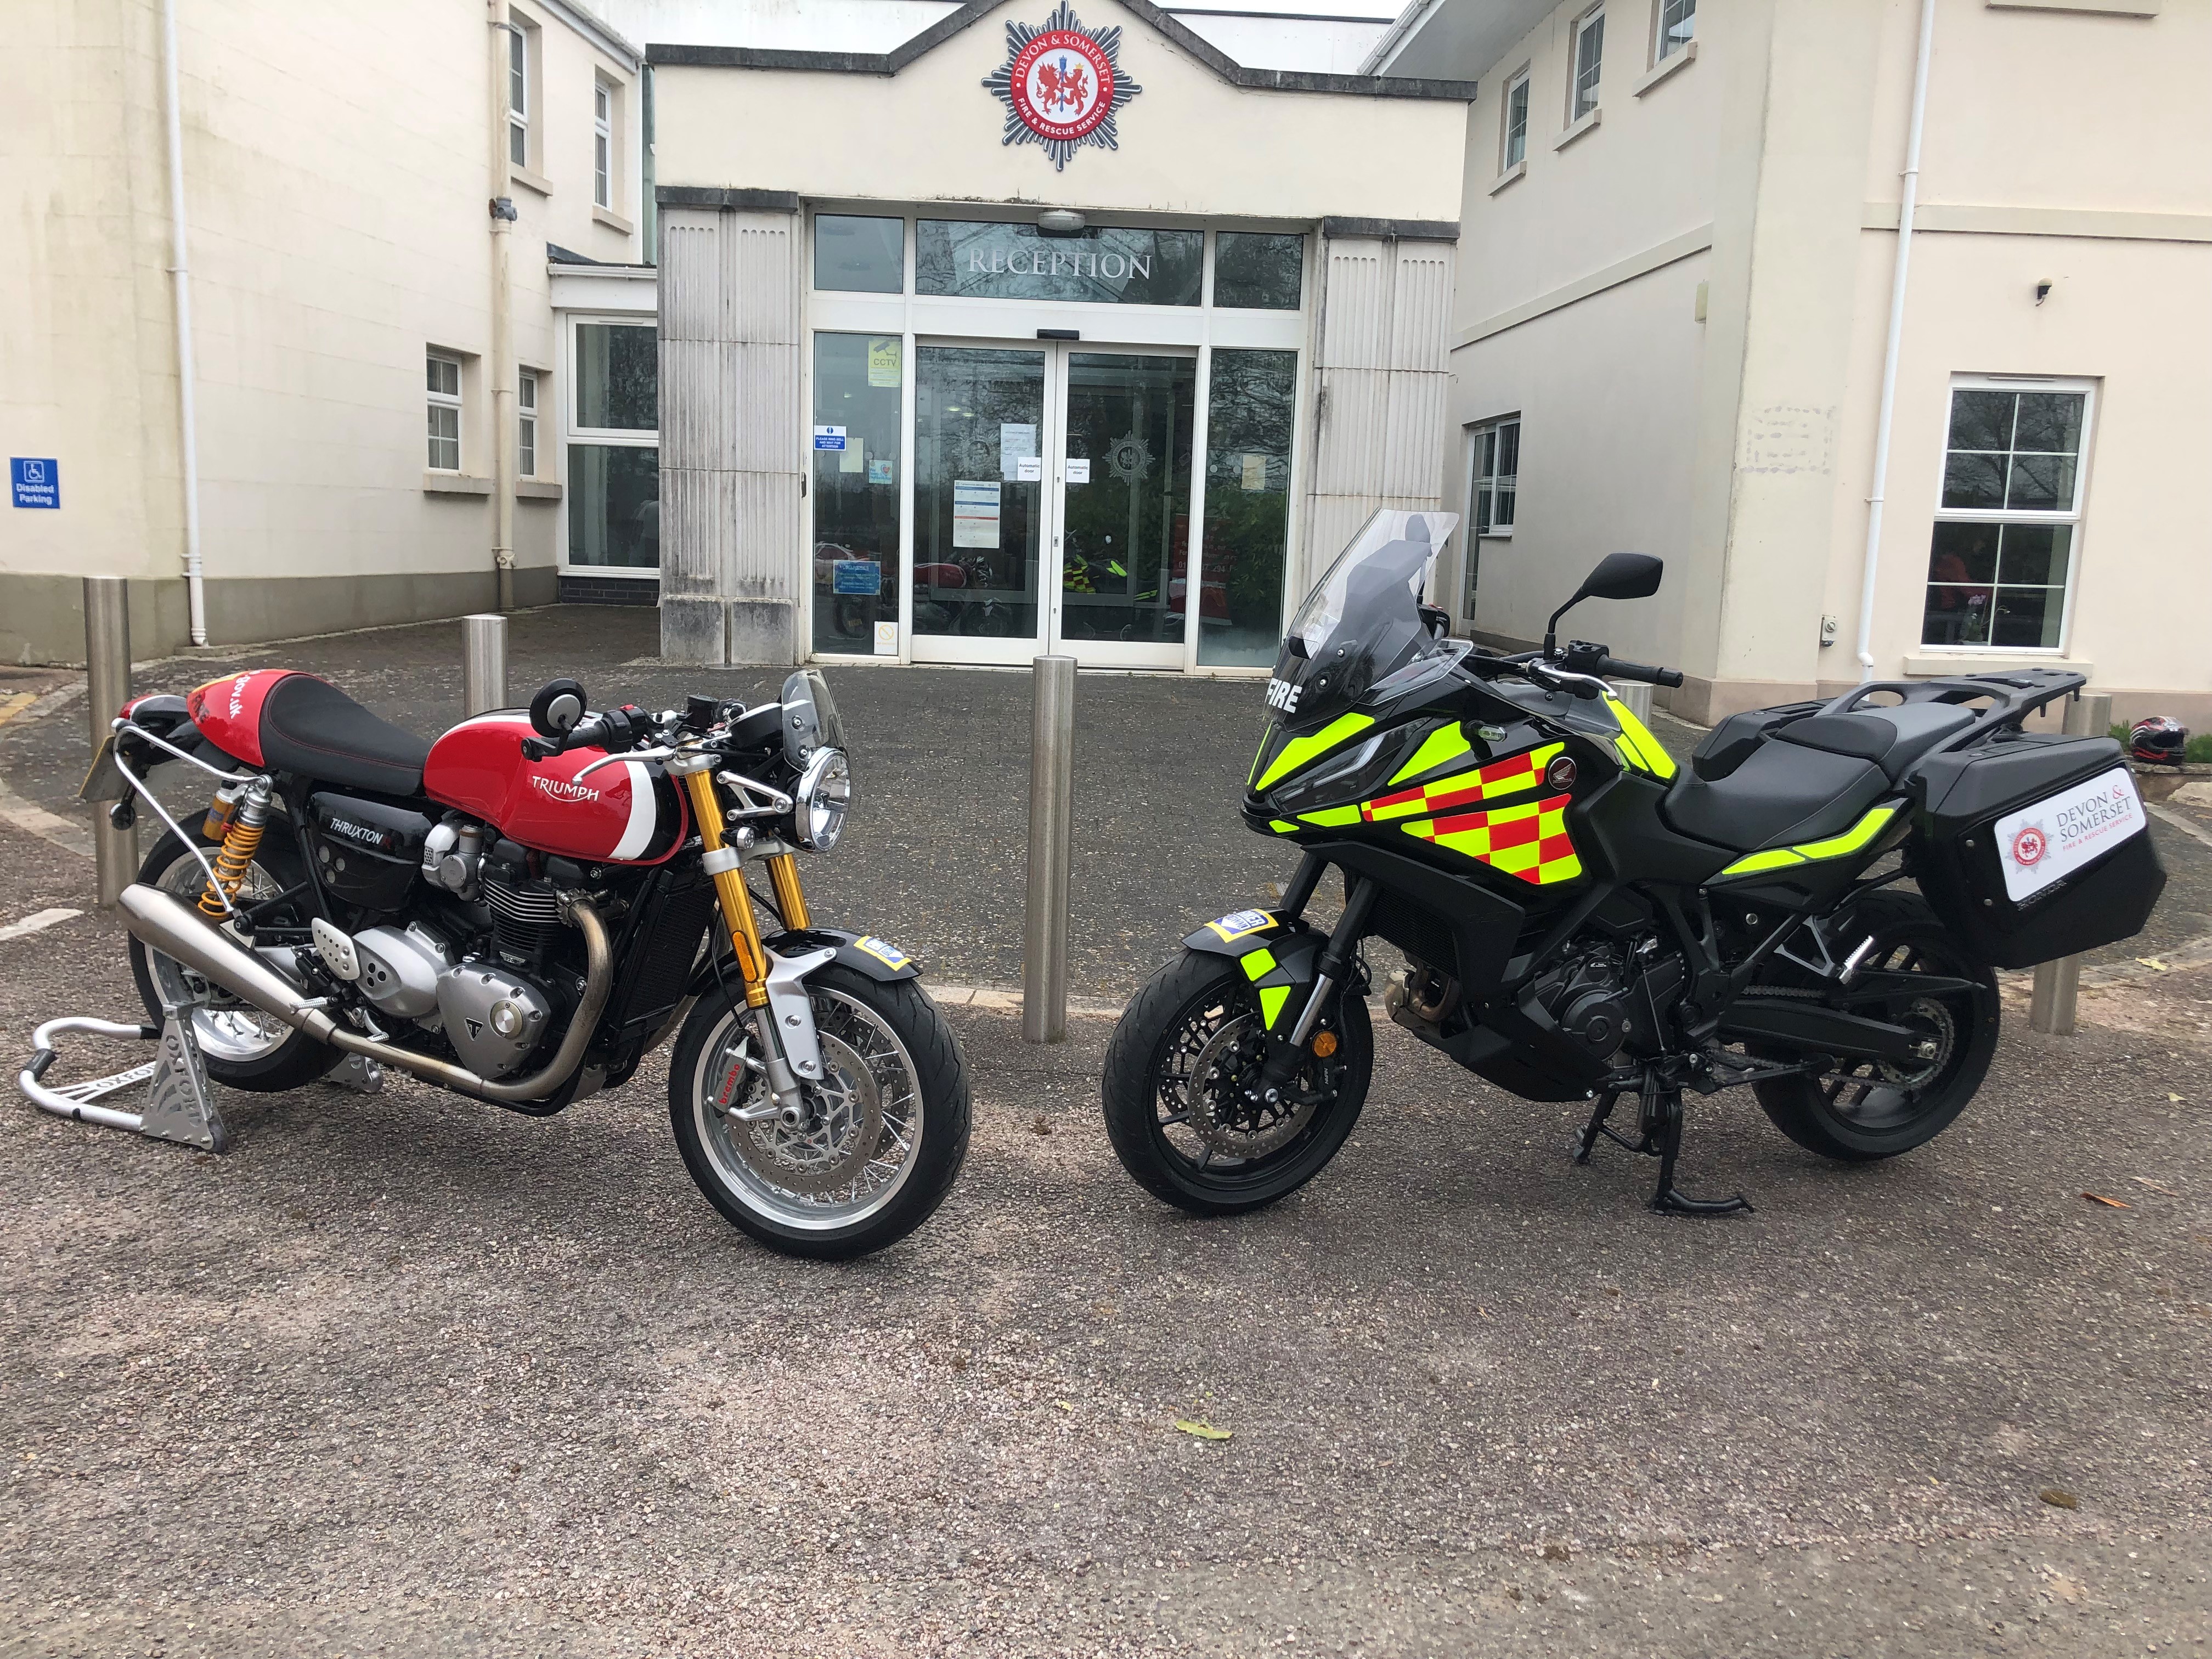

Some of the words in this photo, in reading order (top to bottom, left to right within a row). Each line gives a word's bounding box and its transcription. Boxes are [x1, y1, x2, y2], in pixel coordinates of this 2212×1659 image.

[1015, 37, 1048, 78] DEVON
[1051, 35, 1060, 45] &
[1063, 34, 1110, 83] SOMERSET
[1018, 97, 1032, 119] FIRE
[1039, 122, 1075, 136] RESCUE
[1076, 101, 1106, 132] SERVICE
[967, 247, 1152, 280] RECEPTION
[873, 358, 896, 366] CCTV
[16, 483, 54, 494] Disabled
[19, 494, 53, 506] Parking
[1265, 677, 1303, 714] FIRE
[532, 775, 600, 802] TRIUMPH
[2056, 791, 2108, 827] DEVON
[2112, 785, 2125, 799] &
[330, 817, 383, 844] THRUXTON
[2060, 795, 2130, 842] SOMERSET
[2063, 841, 2076, 851] FIRE
[2084, 826, 2108, 841] RESCUE
[2109, 813, 2133, 829] SERVICE
[166, 1035, 202, 1127] OXFORD
[719, 1063, 741, 1105] brembo
